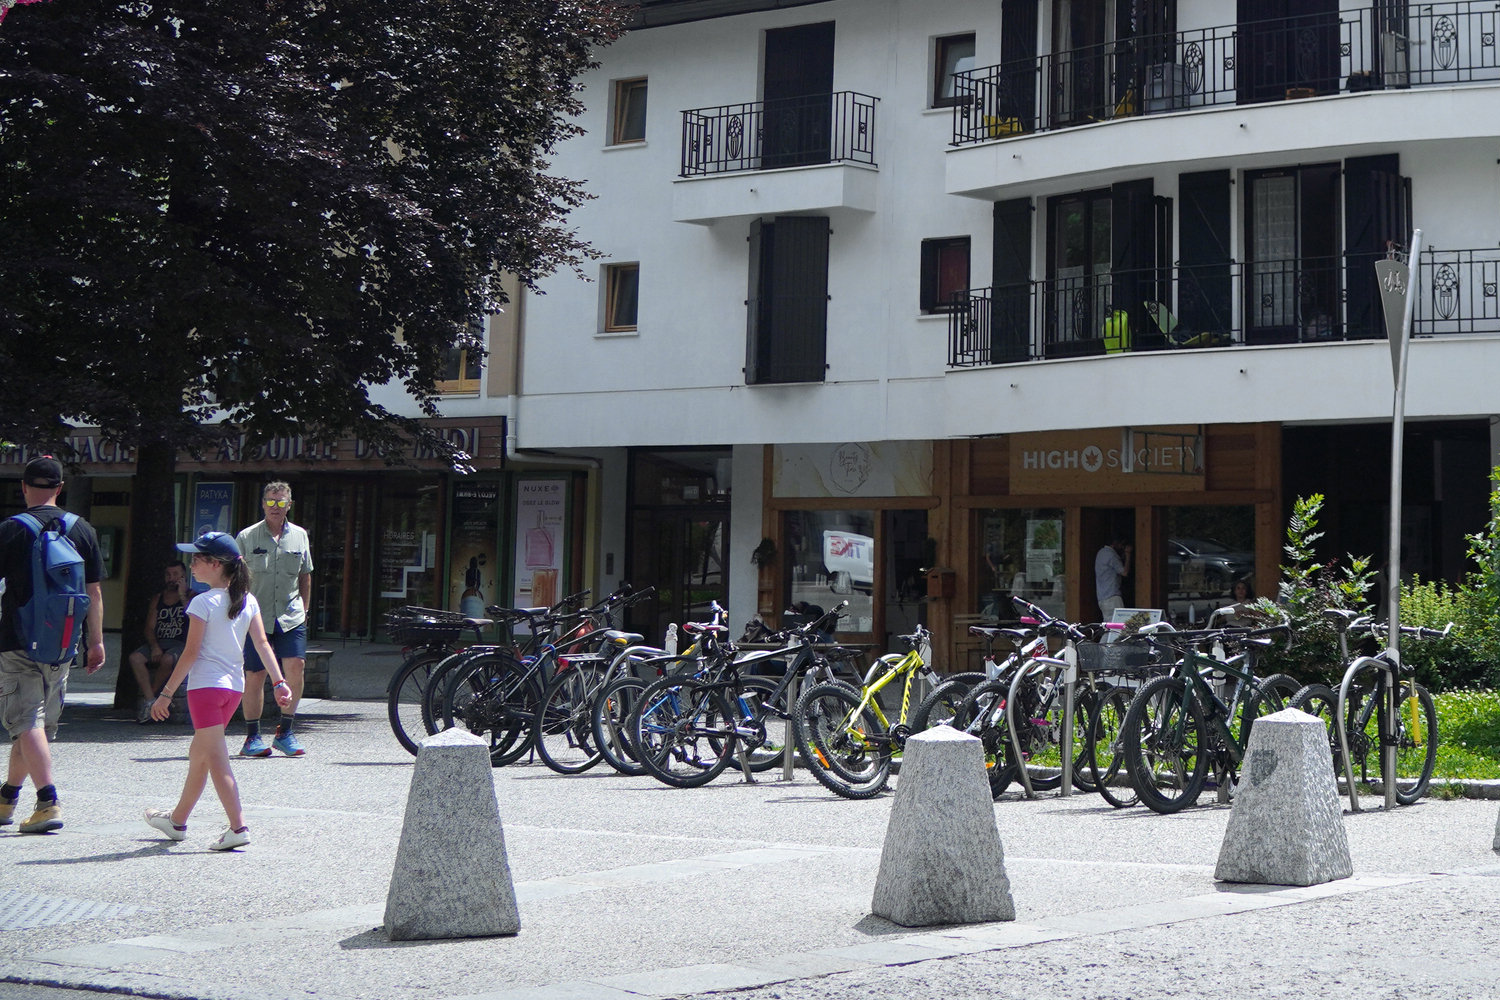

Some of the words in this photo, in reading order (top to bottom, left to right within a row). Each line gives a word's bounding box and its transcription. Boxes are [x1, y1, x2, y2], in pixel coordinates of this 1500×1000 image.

[0, 436, 135, 464] PHAMACIE
[1023, 450, 1078, 470] HIGH
[200, 489, 228, 499] PATYKA
[383, 531, 415, 540] HORAIRES
